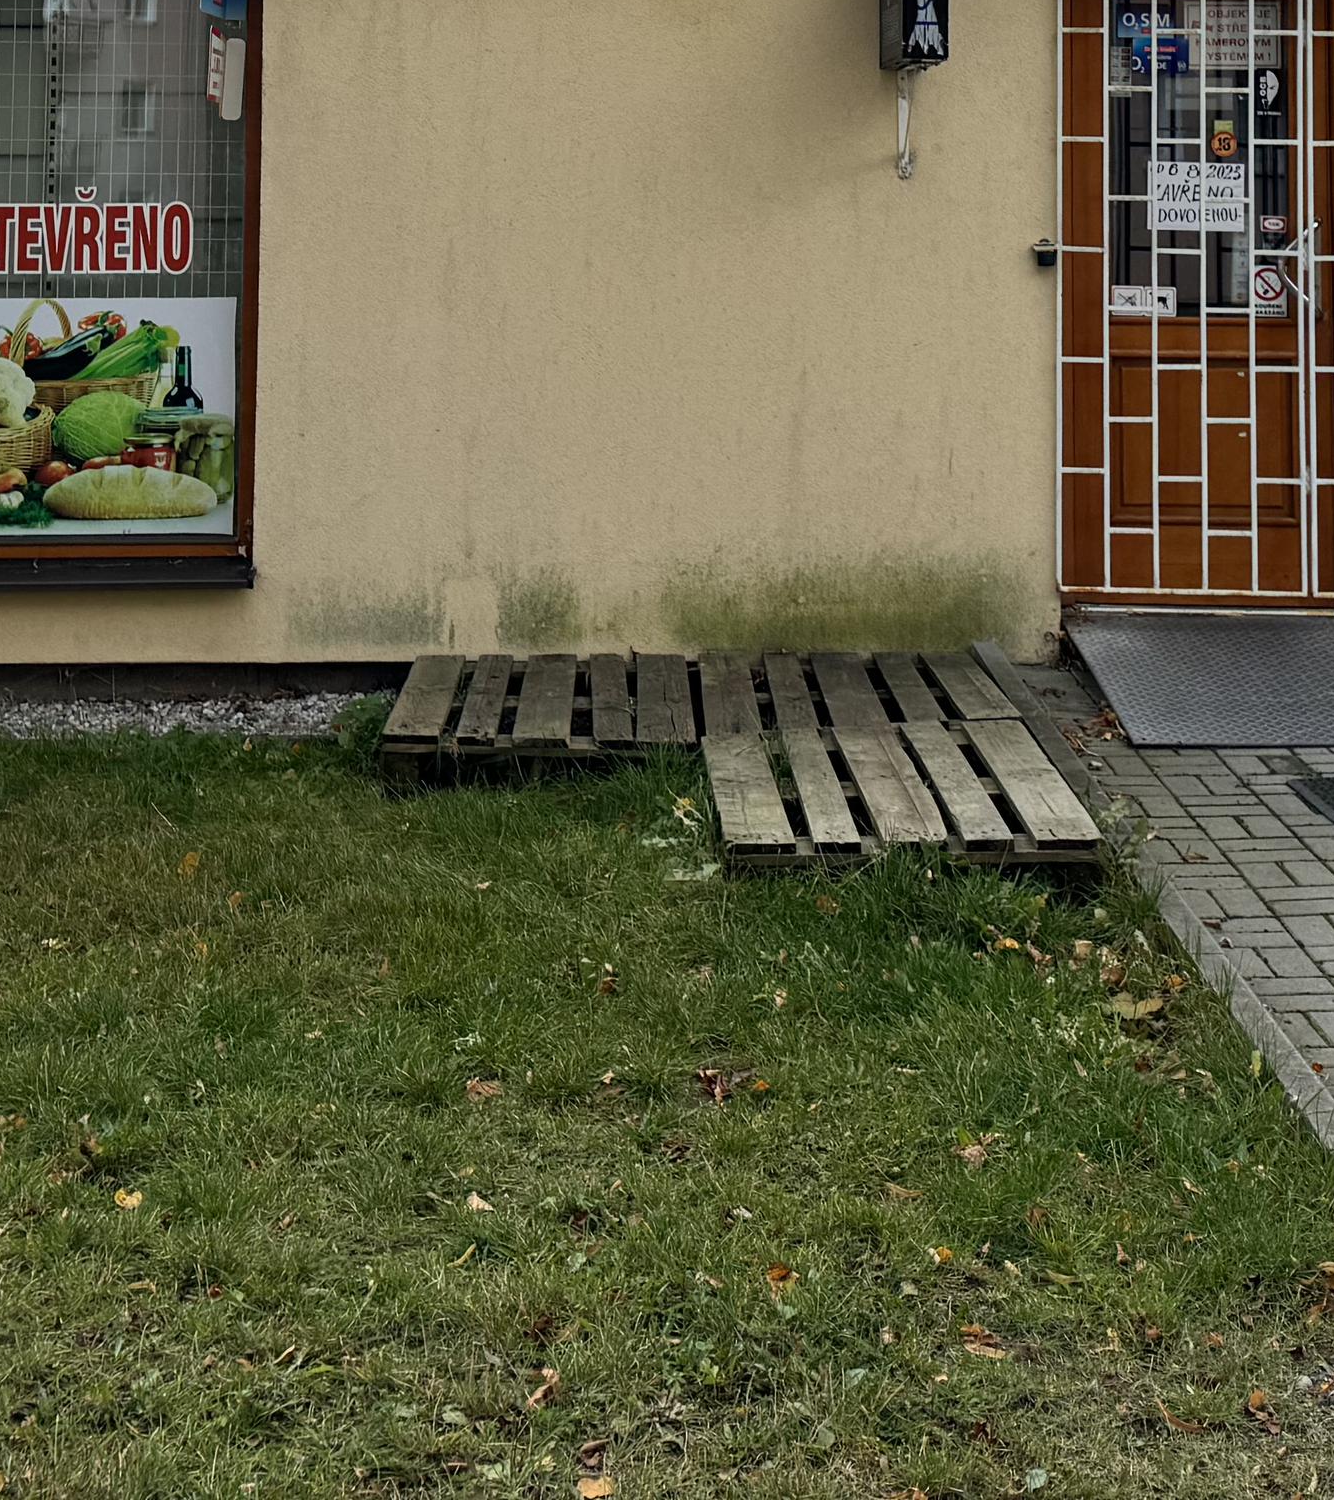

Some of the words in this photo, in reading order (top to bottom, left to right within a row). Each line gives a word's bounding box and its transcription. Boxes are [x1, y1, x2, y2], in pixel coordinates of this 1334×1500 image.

[1140, 12, 1170, 28] SM
[1208, 9, 1249, 20] OBJEK
[1257, 9, 1271, 19] JE
[1217, 21, 1271, 33] STŘEEN
